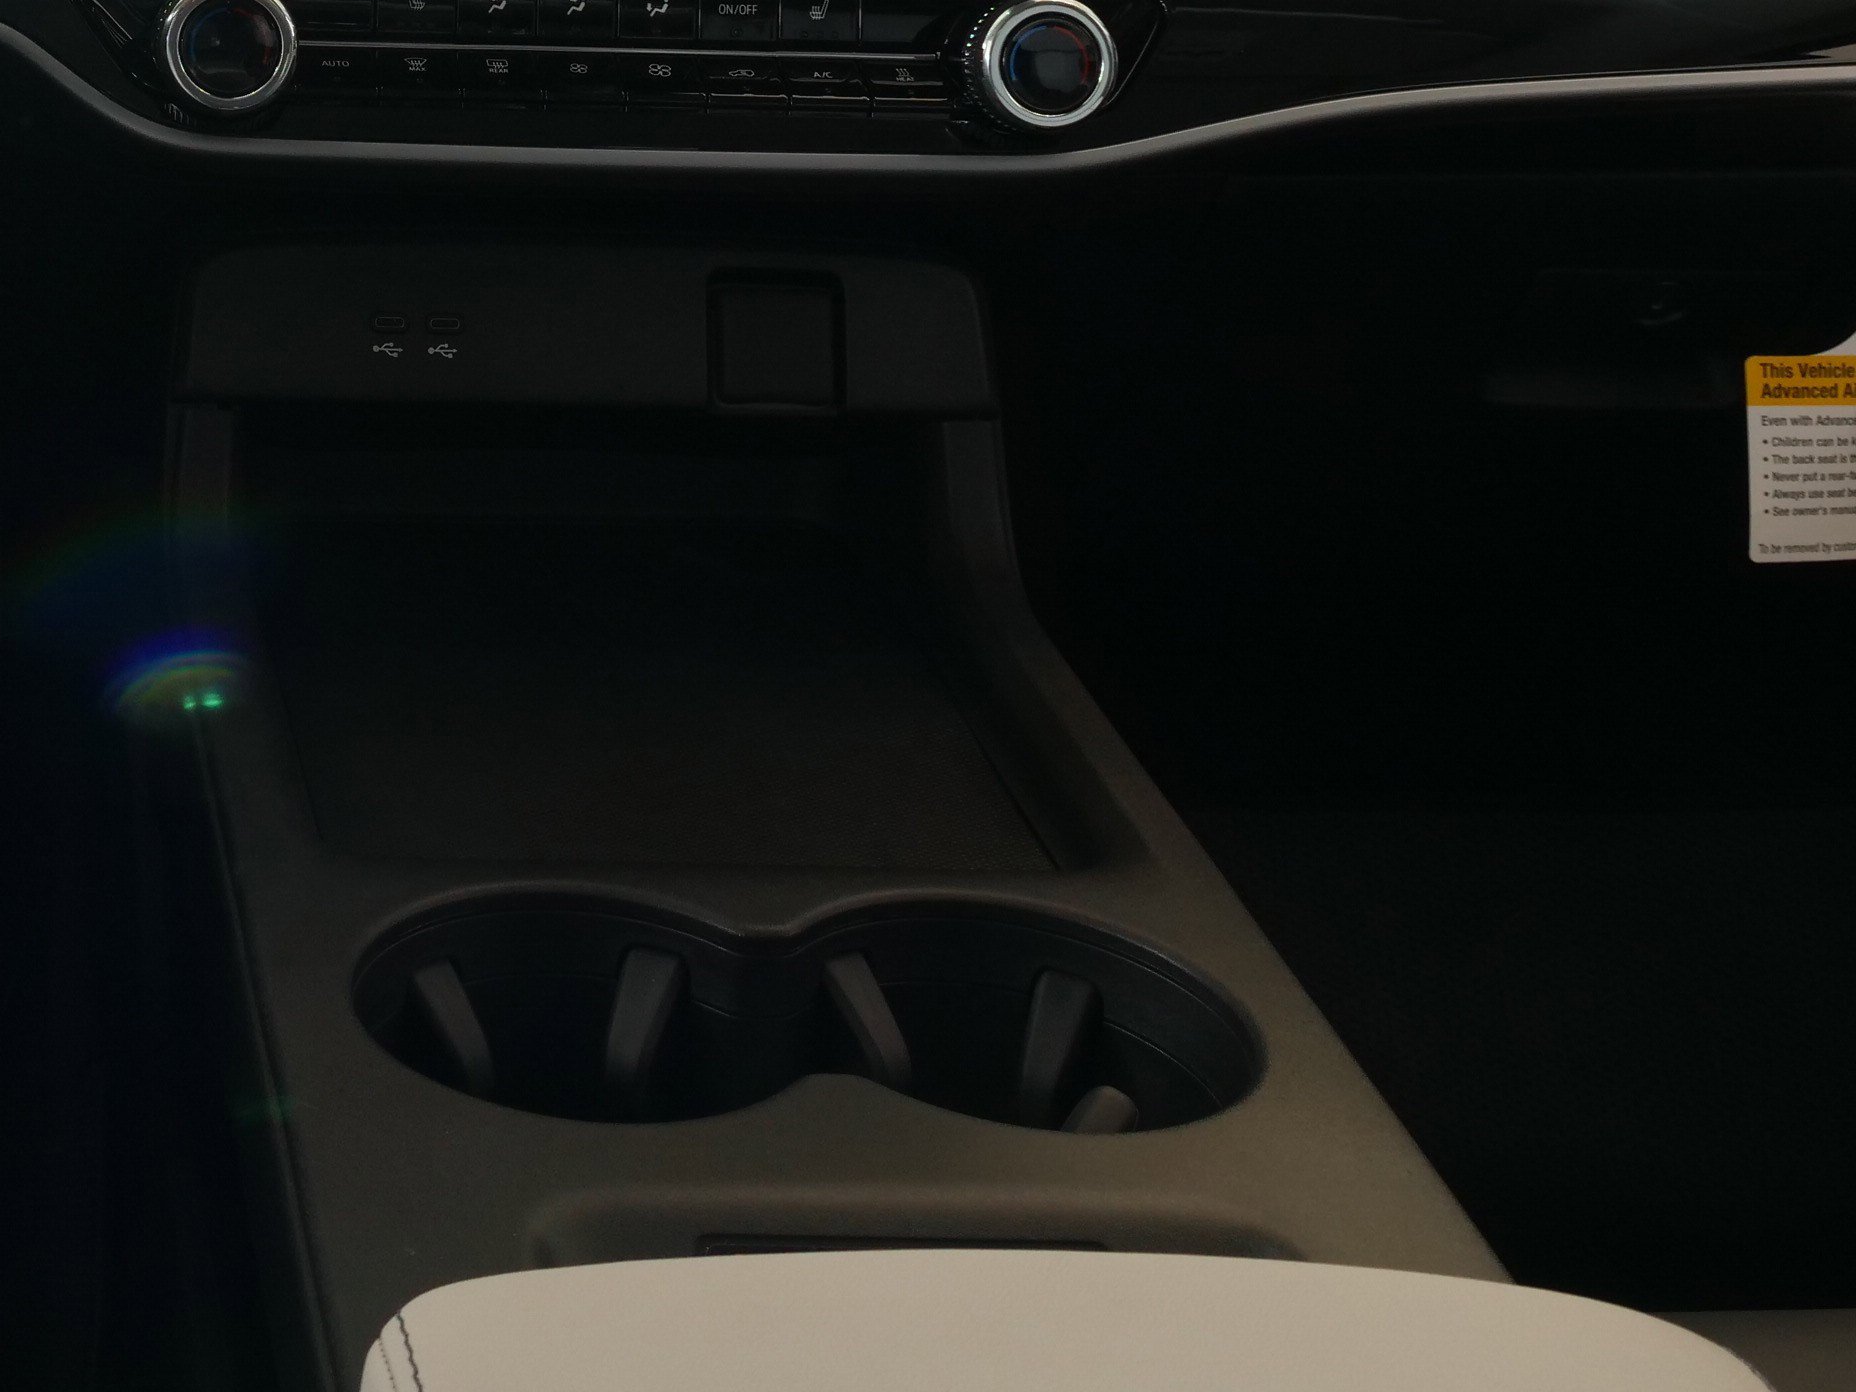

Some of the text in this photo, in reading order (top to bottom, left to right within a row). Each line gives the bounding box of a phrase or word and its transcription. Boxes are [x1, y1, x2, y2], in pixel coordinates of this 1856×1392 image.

[718, 4, 759, 16] ON/OFF
[321, 60, 350, 68] AUTO
[813, 71, 833, 79] A/C
[1759, 363, 1855, 379] This Vehicle
[1760, 383, 1838, 399] Advanced
[1761, 415, 1787, 426] Even
[1790, 415, 1813, 426] with
[1772, 437, 1813, 447] Children
[1816, 438, 1834, 447] can
[1837, 437, 1849, 446] be
[1772, 454, 1789, 464] The
[1792, 454, 1815, 464] back
[1817, 455, 1838, 464] seat
[1840, 454, 1848, 464] is
[1772, 472, 1800, 482] Never
[1802, 472, 1818, 483] put
[1819, 473, 1826, 481] a
[1772, 489, 1806, 501] Always
[1808, 490, 1824, 499] use
[1826, 489, 1846, 498] seat
[1772, 507, 1790, 517] See
[1792, 506, 1828, 517] owner's
[1758, 544, 1769, 554] To
[1770, 544, 1782, 554] be
[1783, 543, 1820, 554] removed
[1822, 543, 1831, 554] by
